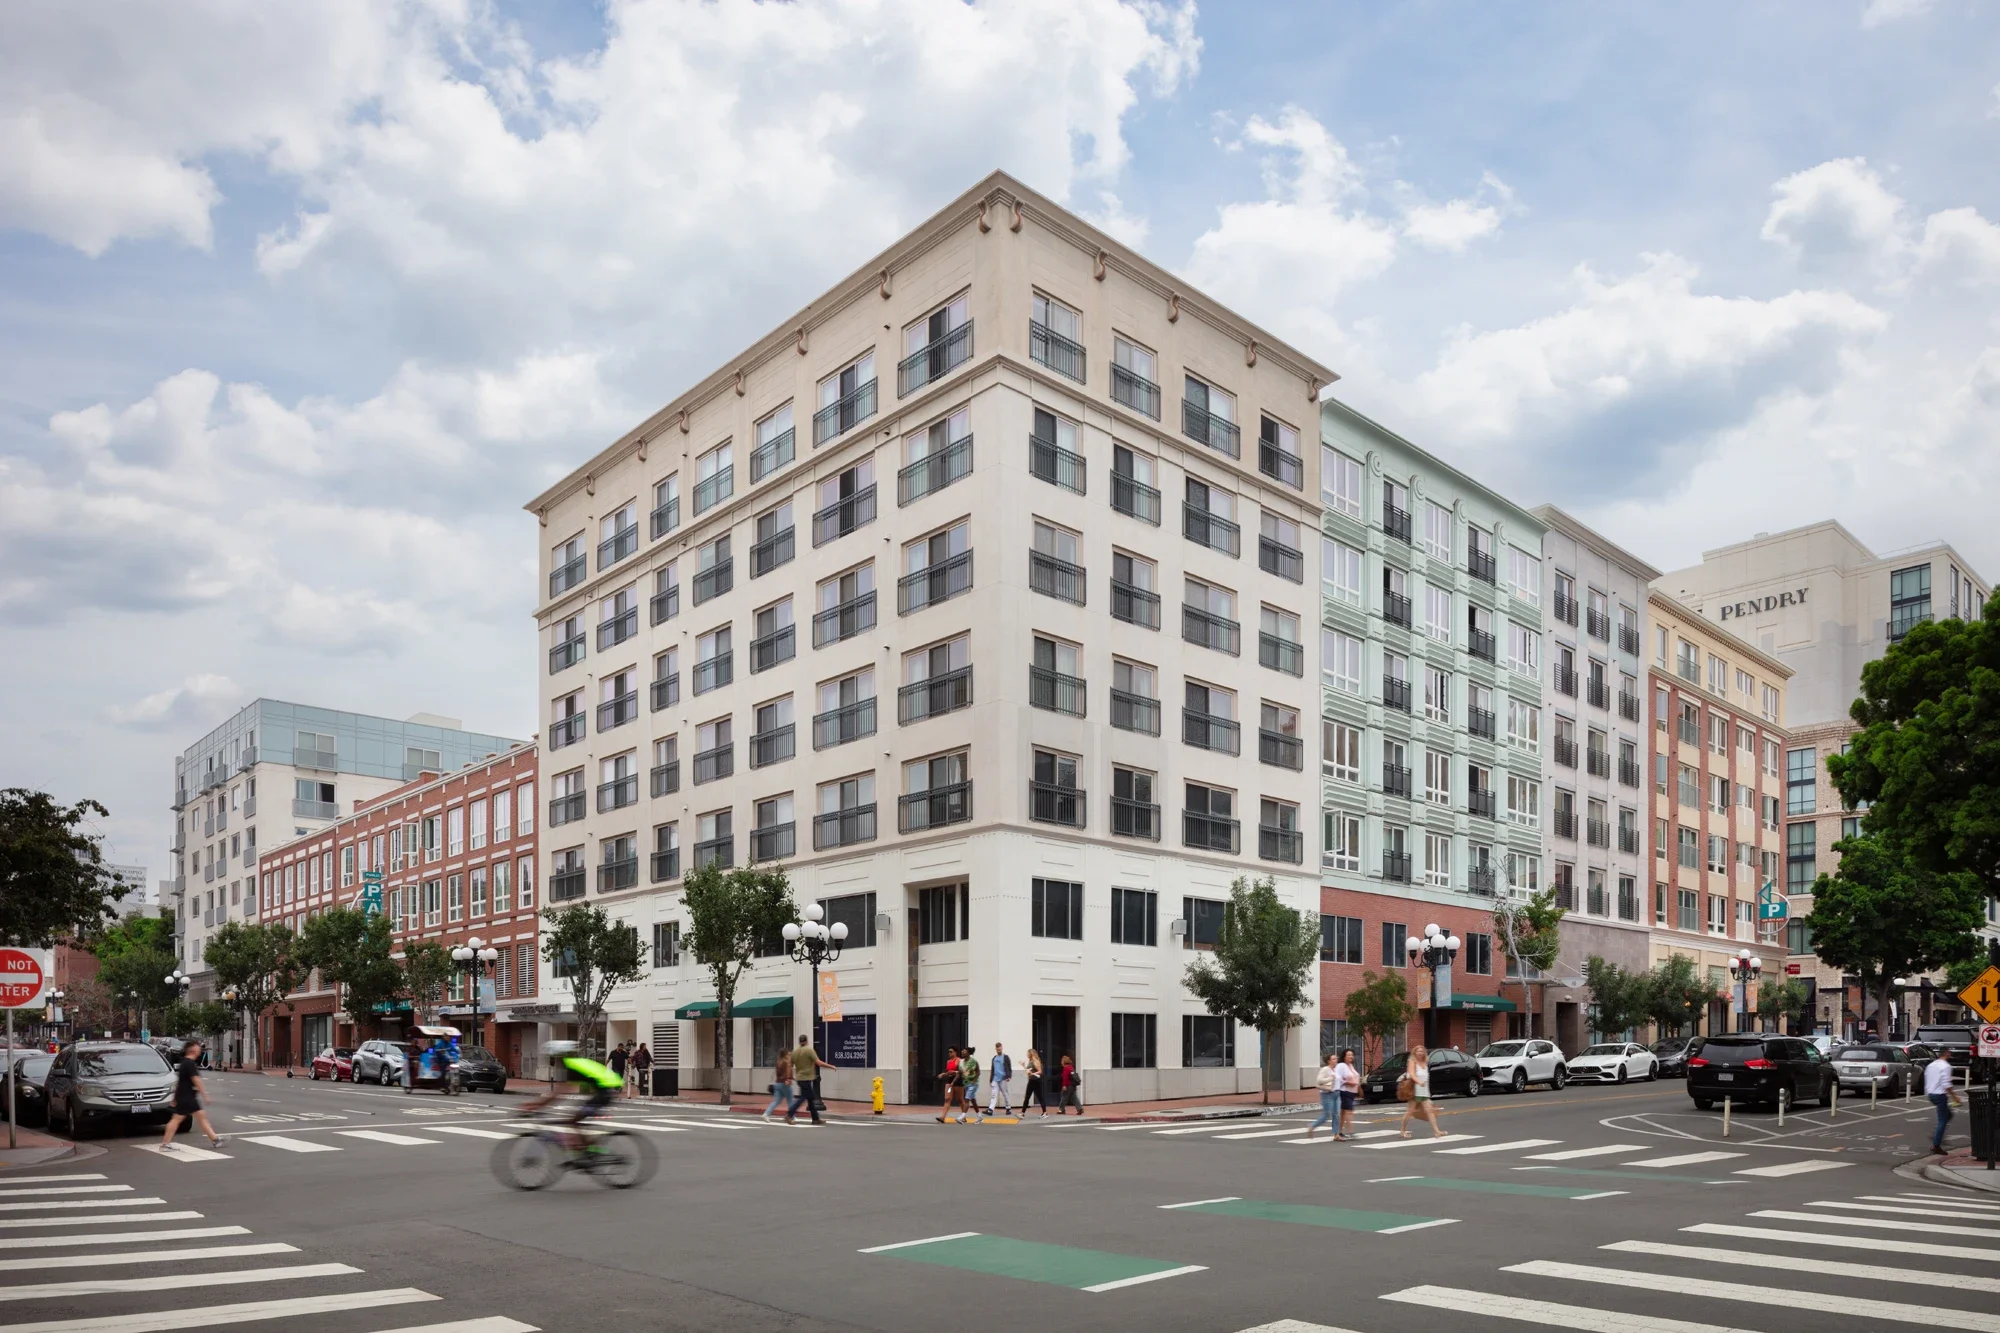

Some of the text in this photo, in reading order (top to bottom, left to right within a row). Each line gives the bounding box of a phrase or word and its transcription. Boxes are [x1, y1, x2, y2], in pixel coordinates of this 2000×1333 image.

[1720, 587, 1809, 621] PENDRY
[1768, 904, 1780, 917] P
[7, 960, 33, 970] NOT
